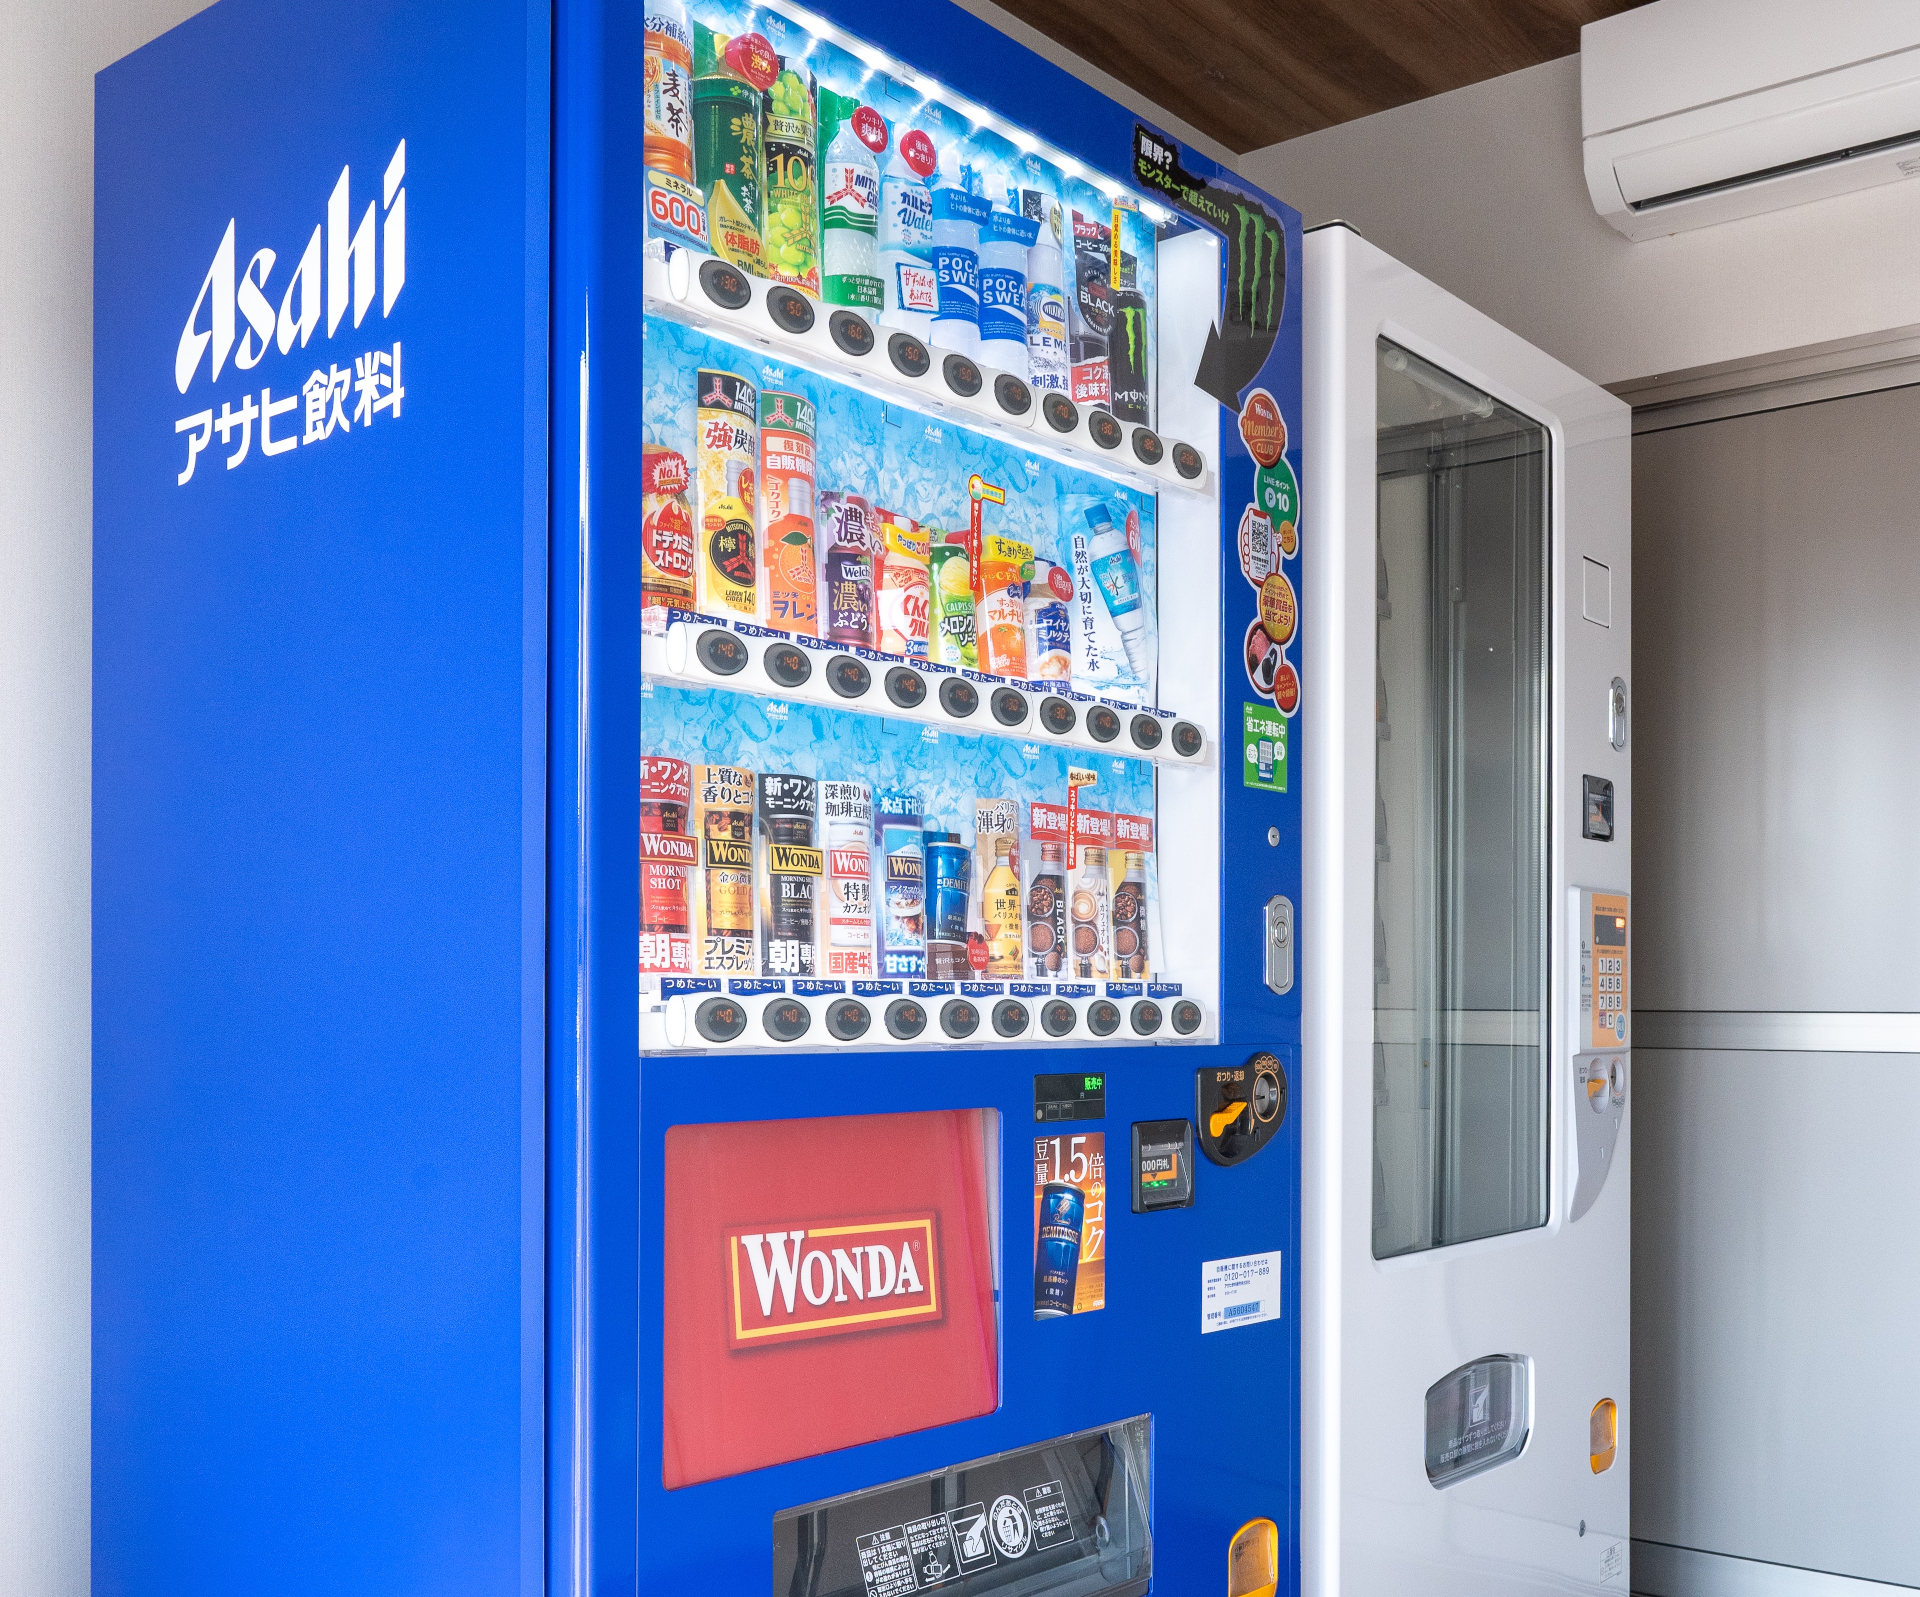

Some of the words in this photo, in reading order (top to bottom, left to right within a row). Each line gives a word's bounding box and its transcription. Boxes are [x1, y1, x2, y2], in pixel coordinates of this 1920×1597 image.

[751, 53, 771, 74] 渋み
[662, 68, 688, 137] 麦茶
[861, 111, 883, 128] スッキリ
[1140, 135, 1173, 171] 限界?
[665, 176, 693, 197] ミネラル
[1137, 157, 1230, 226] モンスターで超えていけ
[1074, 224, 1097, 237] ブラック
[724, 231, 760, 256] 体脂肪
[1075, 239, 1098, 250] コーヒー
[175, 138, 406, 394] Asahi
[857, 285, 877, 296] 日本品質
[1080, 291, 1115, 318] BLACK
[847, 324, 863, 340] 160
[905, 346, 920, 361] 150
[762, 364, 784, 380] Asahi
[175, 341, 406, 486] アサヒ飲料
[1242, 418, 1284, 439] Member's
[1256, 442, 1275, 456] CLUB
[659, 462, 681, 480] No.1
[1276, 491, 1290, 513] 10
[726, 589, 744, 597] LEMON
[726, 595, 743, 603] CIDER
[772, 590, 800, 600] 三ツ矢
[833, 580, 868, 613] 濃い
[1073, 535, 1101, 672] 自然が大切に育てた水
[834, 611, 869, 631] ぶどう
[1264, 609, 1291, 628] 当てよう!
[717, 643, 735, 658] 140
[783, 655, 799, 671] 140
[844, 668, 860, 682] 140
[901, 679, 916, 693] 140
[954, 689, 969, 702] 140
[766, 701, 788, 715] Asahi
[1246, 716, 1286, 739] 省エネ運転中
[702, 767, 744, 786] 上質な
[825, 784, 861, 801] 深煎り
[1076, 812, 1111, 837] 新登場!
[1117, 817, 1150, 842] 新登場!
[641, 832, 695, 859] WONDA
[773, 845, 821, 869] WONDA
[650, 877, 682, 890] SHOT
[1056, 899, 1065, 944] BLACK
[716, 1008, 733, 1023] 140
[782, 1008, 798, 1023] 140
[843, 1008, 859, 1023] 140
[900, 1008, 916, 1023] 140
[955, 1008, 969, 1022] 130
[1007, 1008, 1019, 1022] 140
[1085, 1077, 1103, 1090] 販売中
[1216, 1070, 1245, 1082] おつり・返却
[1035, 1138, 1049, 1186] 豆量
[1049, 1136, 1087, 1184] 1.5
[1084, 1152, 1105, 1263] 倍のコク
[1042, 1226, 1079, 1245] DEMITASSE
[741, 1230, 923, 1317] WONDA
